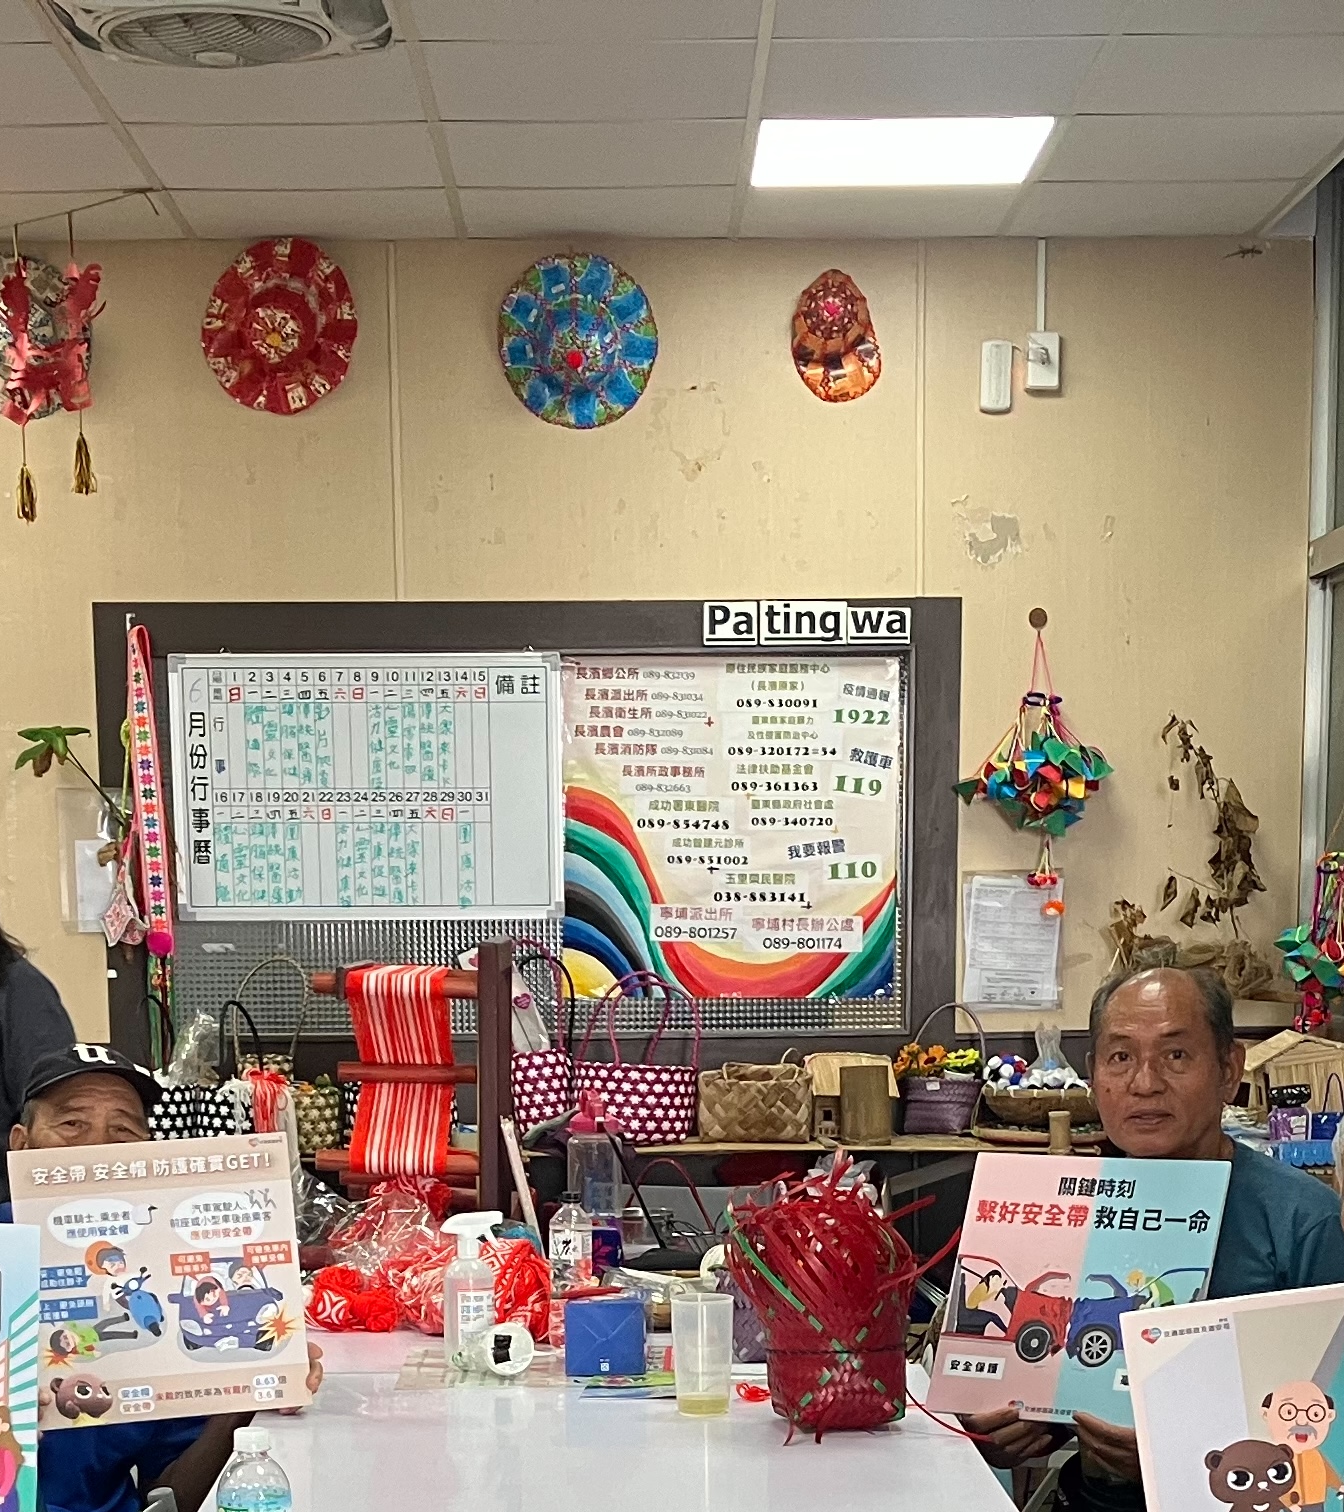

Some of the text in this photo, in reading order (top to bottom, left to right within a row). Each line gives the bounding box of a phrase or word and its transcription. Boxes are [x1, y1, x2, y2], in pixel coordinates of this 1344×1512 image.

[708, 604, 906, 641] Pa ting wa
[233, 671, 485, 682] 1 2 3 4 5 6 7 8 9 10 11 12 13 14 15
[495, 673, 541, 696] 備註
[229, 687, 240, 700] 日
[281, 690, 294, 700] 三
[316, 689, 329, 700] 五
[335, 688, 346, 699] 六
[353, 688, 363, 699] 日
[403, 689, 413, 699] 三
[438, 689, 450, 699] 五
[456, 687, 467, 698] 六
[474, 687, 485, 699] 日
[736, 699, 818, 708] 089-830091
[589, 706, 652, 719] 長濱衛生所
[833, 708, 890, 725] 1922
[849, 747, 894, 769] 救護車
[736, 764, 814, 775] 法律扶助基金會
[188, 711, 211, 864] 月份行事曆
[636, 784, 690, 793] 089-832663
[731, 781, 818, 791] 089-361363
[833, 775, 882, 796] 119
[214, 791, 488, 802] 16 17 18 19 20 21 22 23 24 25 26 27 28 29 30 31
[249, 810, 262, 819] 三
[287, 810, 299, 821] 五
[303, 807, 315, 819] 六
[322, 808, 331, 820] 日
[407, 809, 421, 819] 五
[425, 807, 436, 819] 六
[442, 808, 453, 820] 日
[637, 818, 730, 830] 089-854748
[751, 817, 833, 826] 089-340720
[787, 839, 845, 860] 我要報警
[667, 856, 748, 865] 089-851002
[827, 861, 877, 880] 110
[714, 892, 805, 902] 038-883141
[751, 918, 854, 932] 寧埔村長辦公處
[655, 927, 737, 939] 089-801257
[763, 938, 842, 950] 089-801174
[32, 1165, 86, 1185] 安全帶
[93, 1160, 147, 1180] 安全帽
[1058, 1178, 1136, 1198] 關鍵時刻
[975, 1200, 1211, 1233] 繫好安全帶 救自己一命
[66, 1226, 129, 1239] 應使用安全帽
[190, 1227, 252, 1240] 應使用安全帶
[950, 1360, 998, 1374] 安全保護
